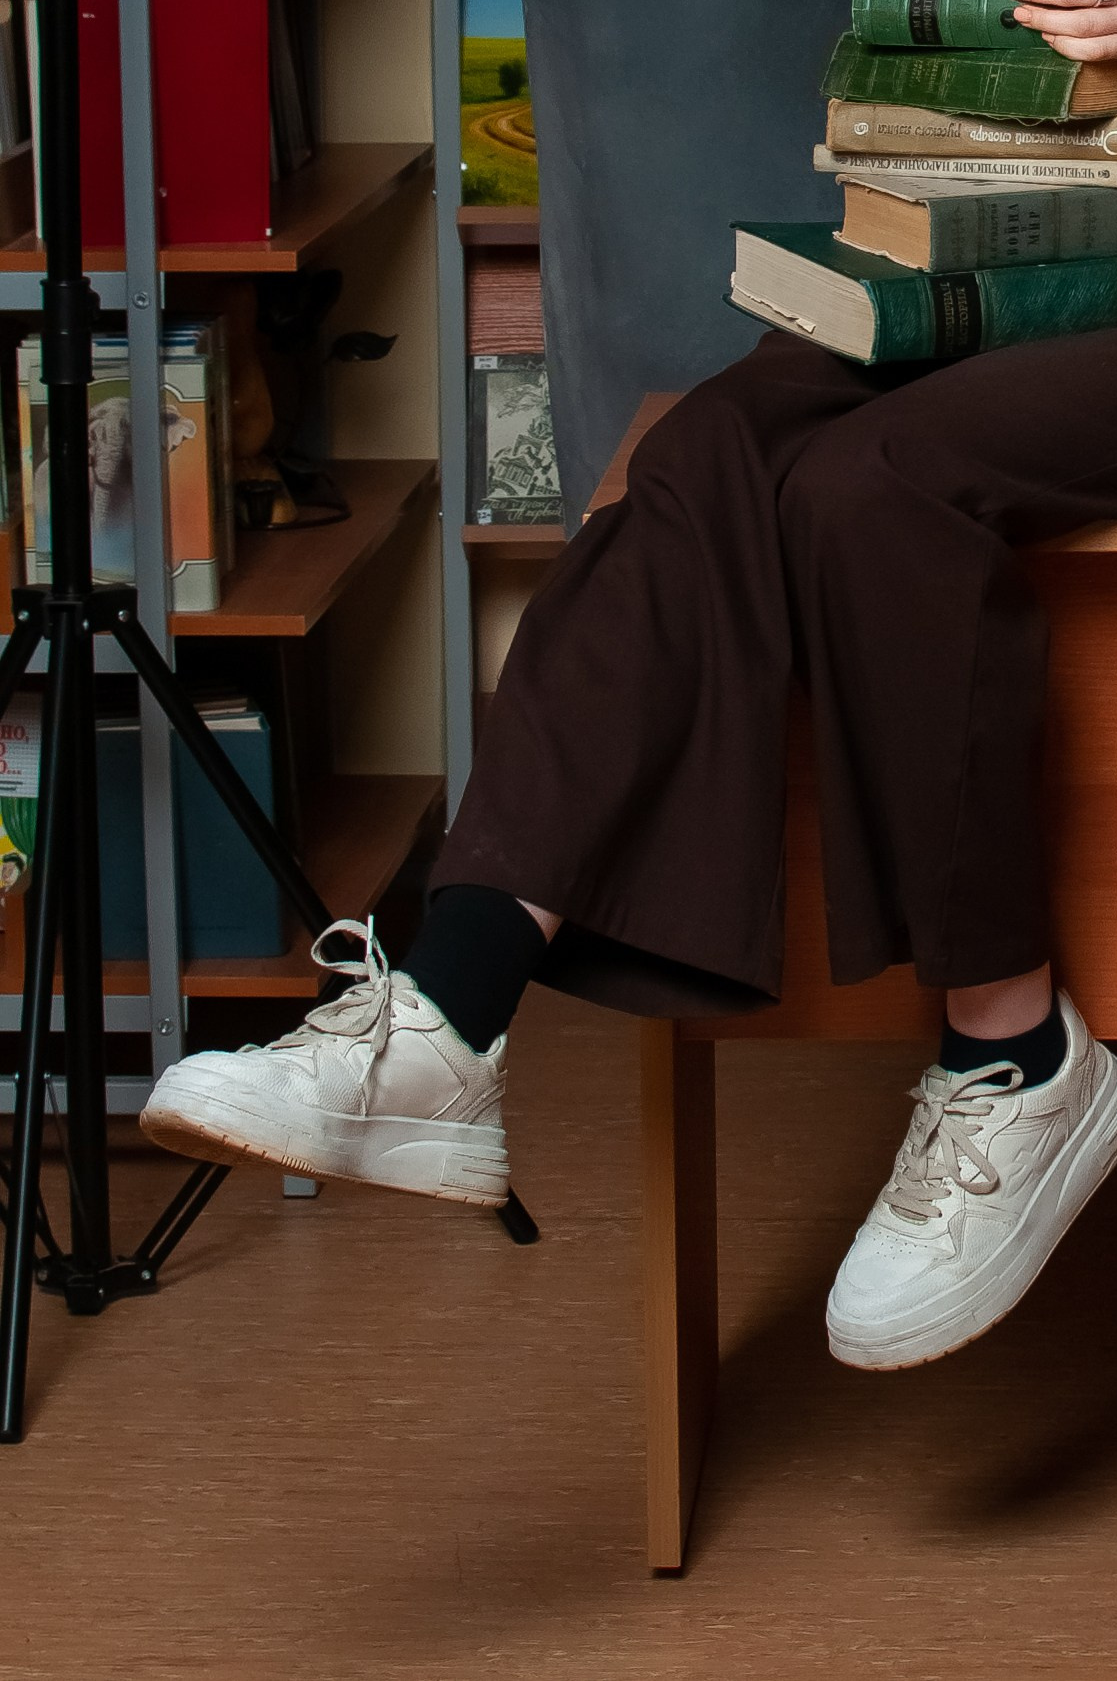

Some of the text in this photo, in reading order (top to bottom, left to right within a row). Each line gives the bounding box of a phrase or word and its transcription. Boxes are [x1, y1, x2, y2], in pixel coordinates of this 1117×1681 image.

[915, 122, 963, 140] русского
[969, 124, 1012, 144] словарь
[850, 156, 1096, 179] ЧЕЧЕНСКИЕ И ИНГУШСКИЕ НАРОДНЫЕ СКАЗКИ
[1003, 203, 1020, 257] ВОЙНА
[1027, 211, 1041, 246] МИР
[939, 282, 957, 353] ВСЕМИРНАЯ
[955, 287, 969, 346] ИСТОРИЯ
